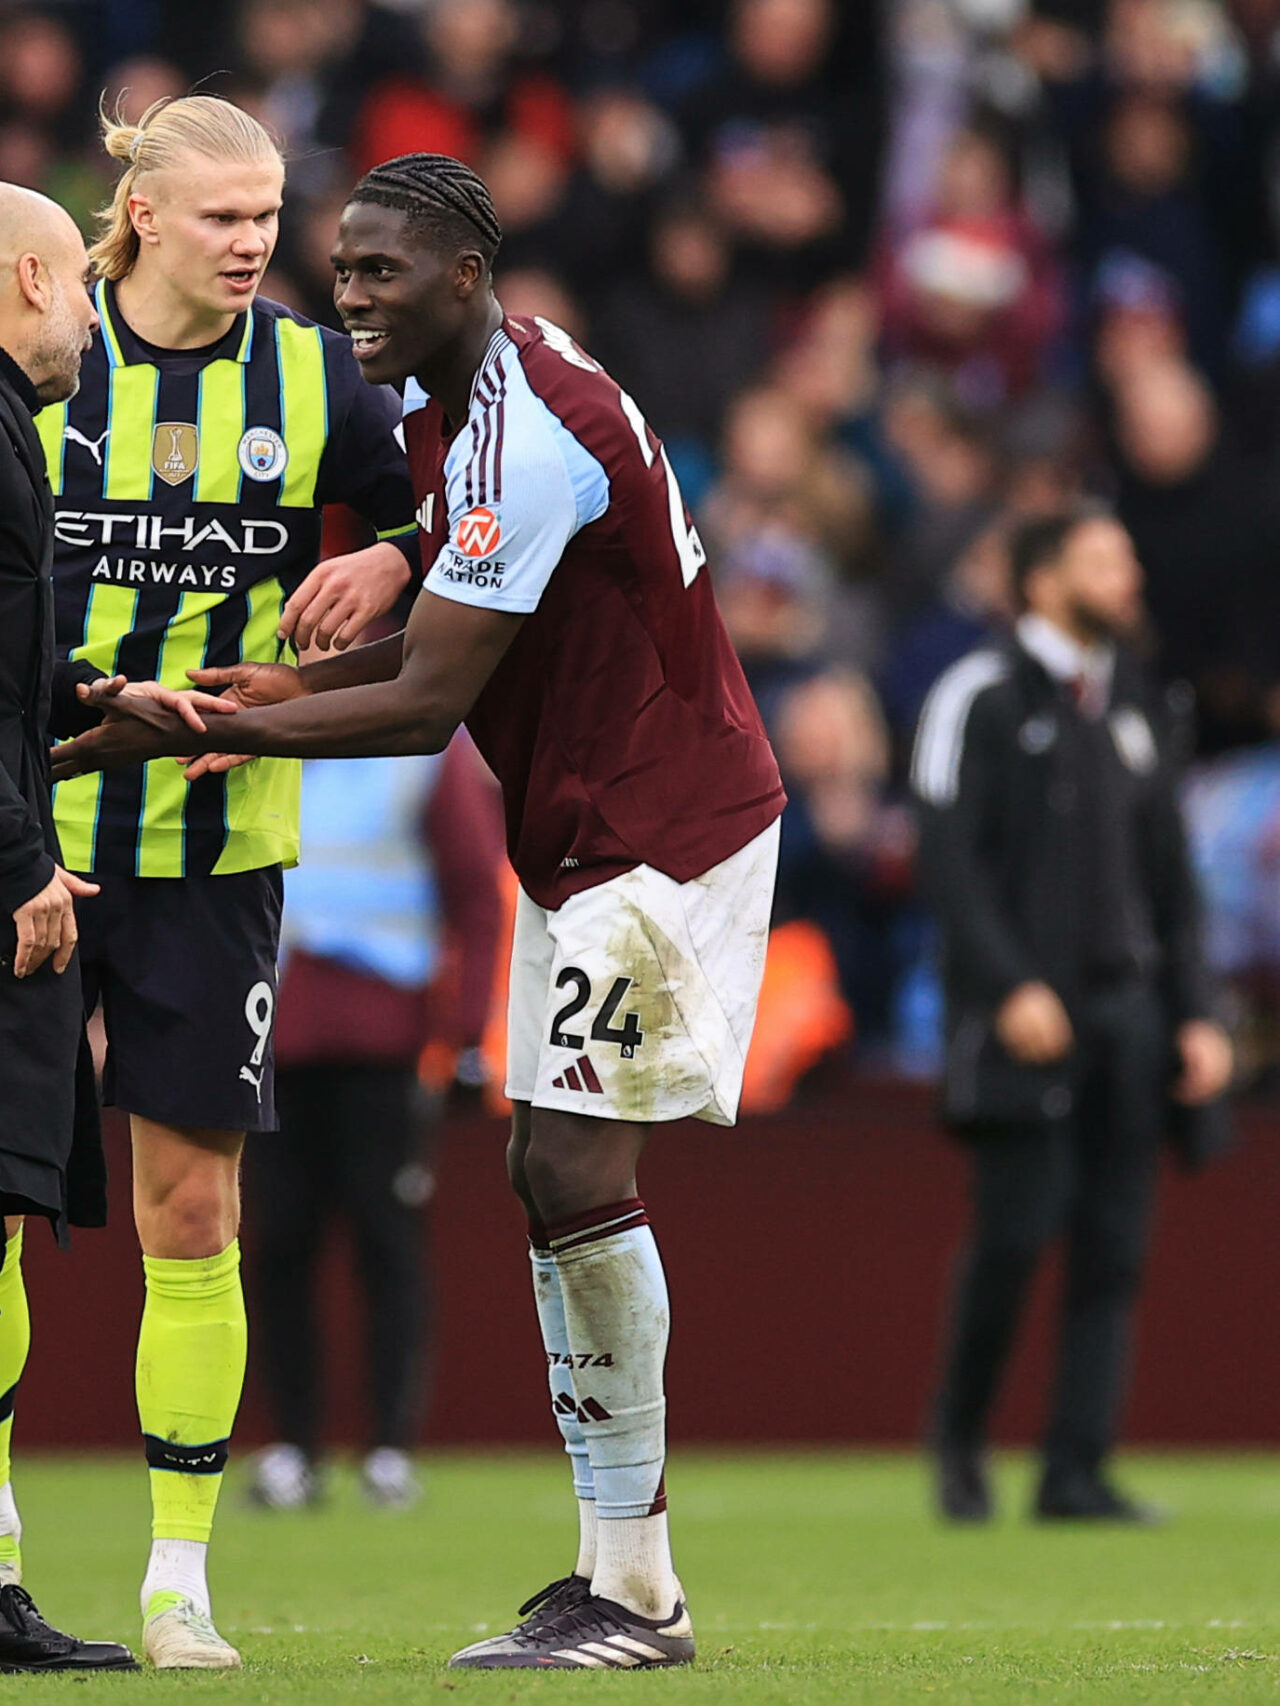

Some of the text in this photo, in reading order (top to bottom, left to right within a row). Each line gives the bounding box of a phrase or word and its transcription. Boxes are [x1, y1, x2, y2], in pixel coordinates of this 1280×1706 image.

[164, 461, 186, 470] FIFA
[54, 511, 289, 555] ETIHAD
[92, 555, 236, 588] AIRWAYS
[448, 550, 507, 575] TRADE
[245, 981, 273, 1065] 9
[549, 966, 644, 1059] 24
